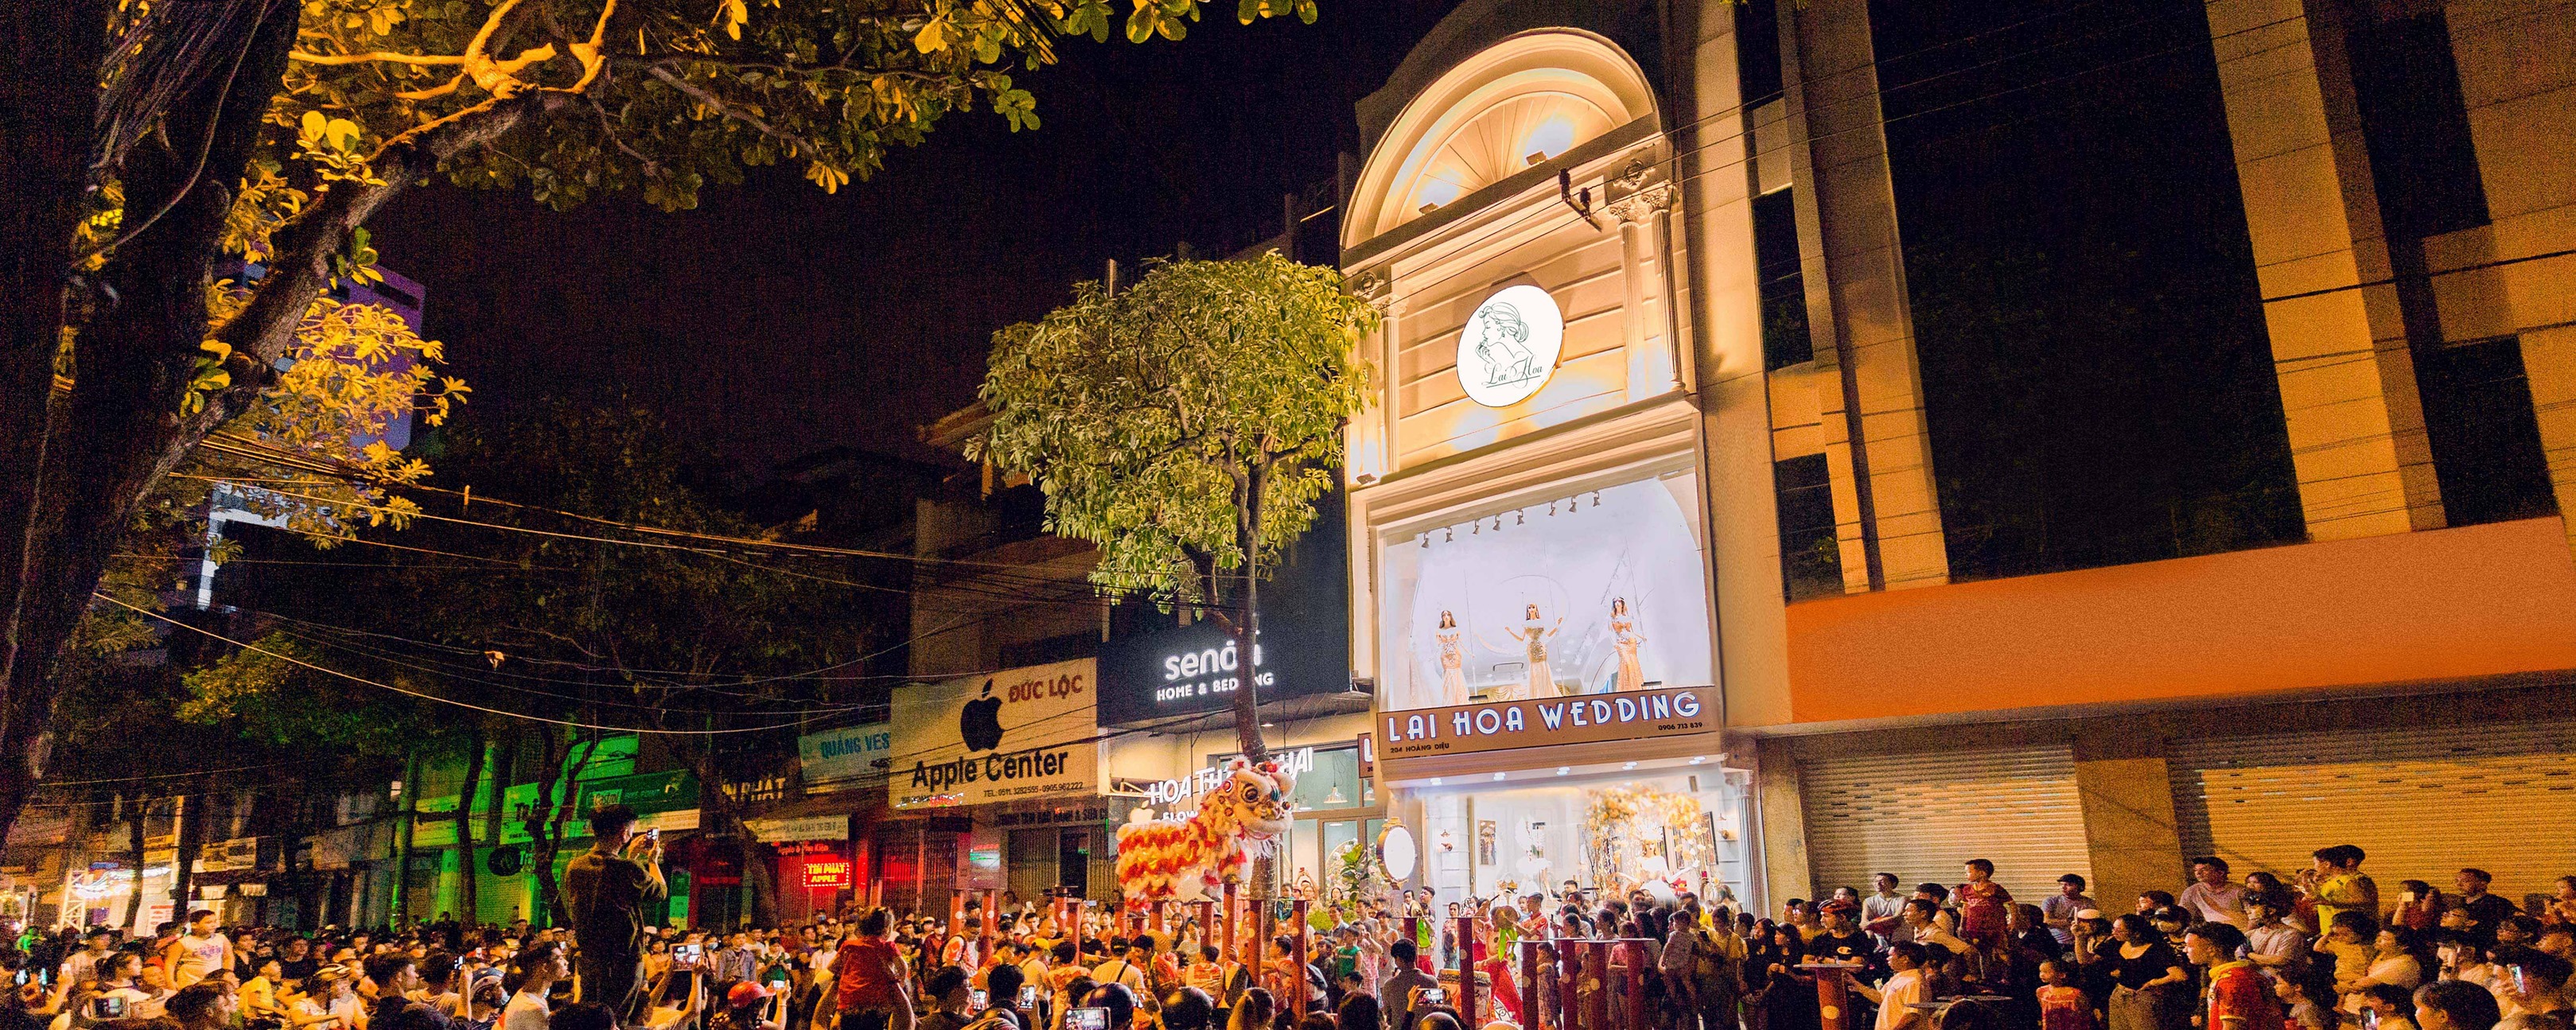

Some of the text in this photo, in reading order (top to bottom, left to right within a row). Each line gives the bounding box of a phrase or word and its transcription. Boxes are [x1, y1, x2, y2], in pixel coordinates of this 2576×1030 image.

[1481, 361, 1508, 386] Lai
[1008, 674, 1083, 703] ĐỨC LỘC
[1157, 672, 1274, 702] HOME & BEDNG
[1387, 690, 1701, 742] LAI HOA WEDDING
[864, 732, 890, 752] VES
[912, 750, 1069, 792] Apple Center
[1145, 775, 1192, 805] HOA
